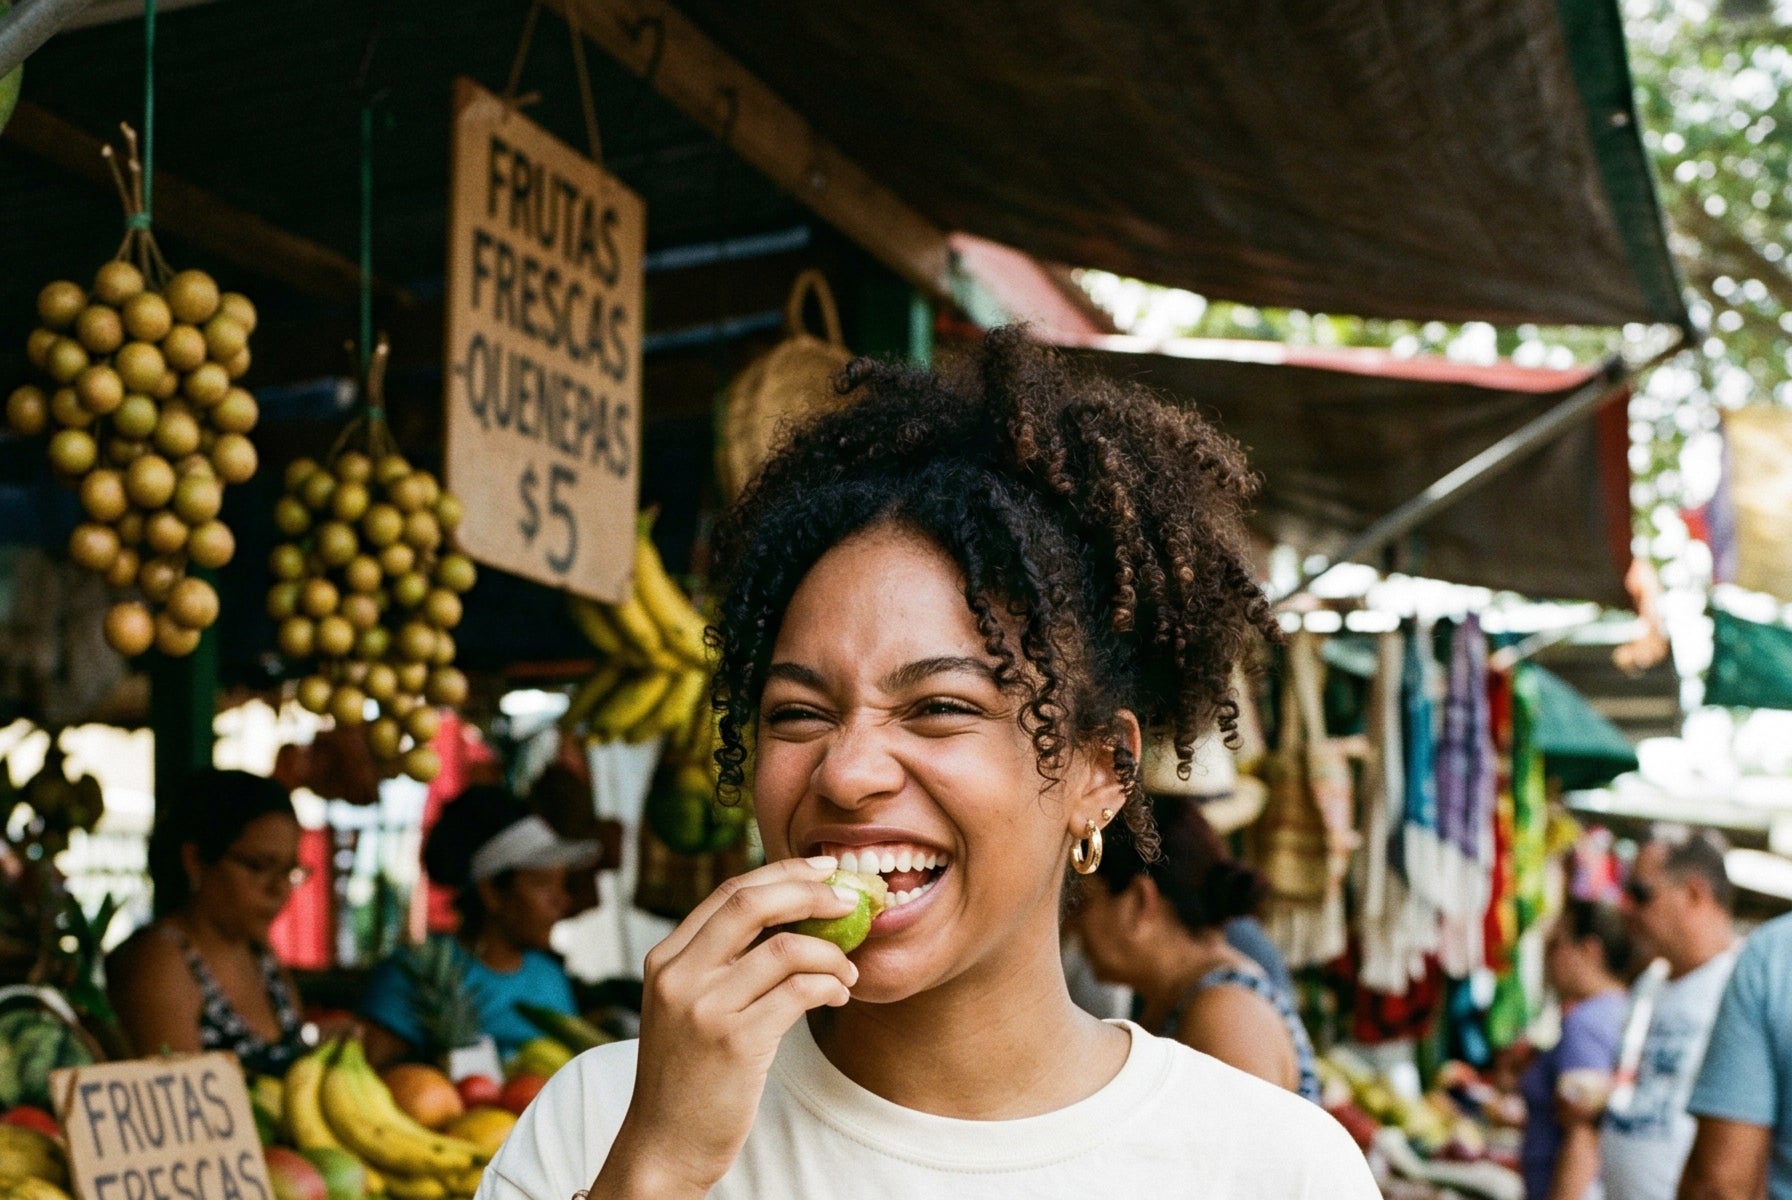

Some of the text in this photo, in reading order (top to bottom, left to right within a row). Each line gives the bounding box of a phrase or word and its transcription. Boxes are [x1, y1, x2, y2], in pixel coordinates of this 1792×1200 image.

[486, 132, 620, 289] FRUTAS
[472, 227, 629, 384] FRESCAS
[518, 458, 579, 574] $5
[79, 1069, 236, 1158] FRUTAS
